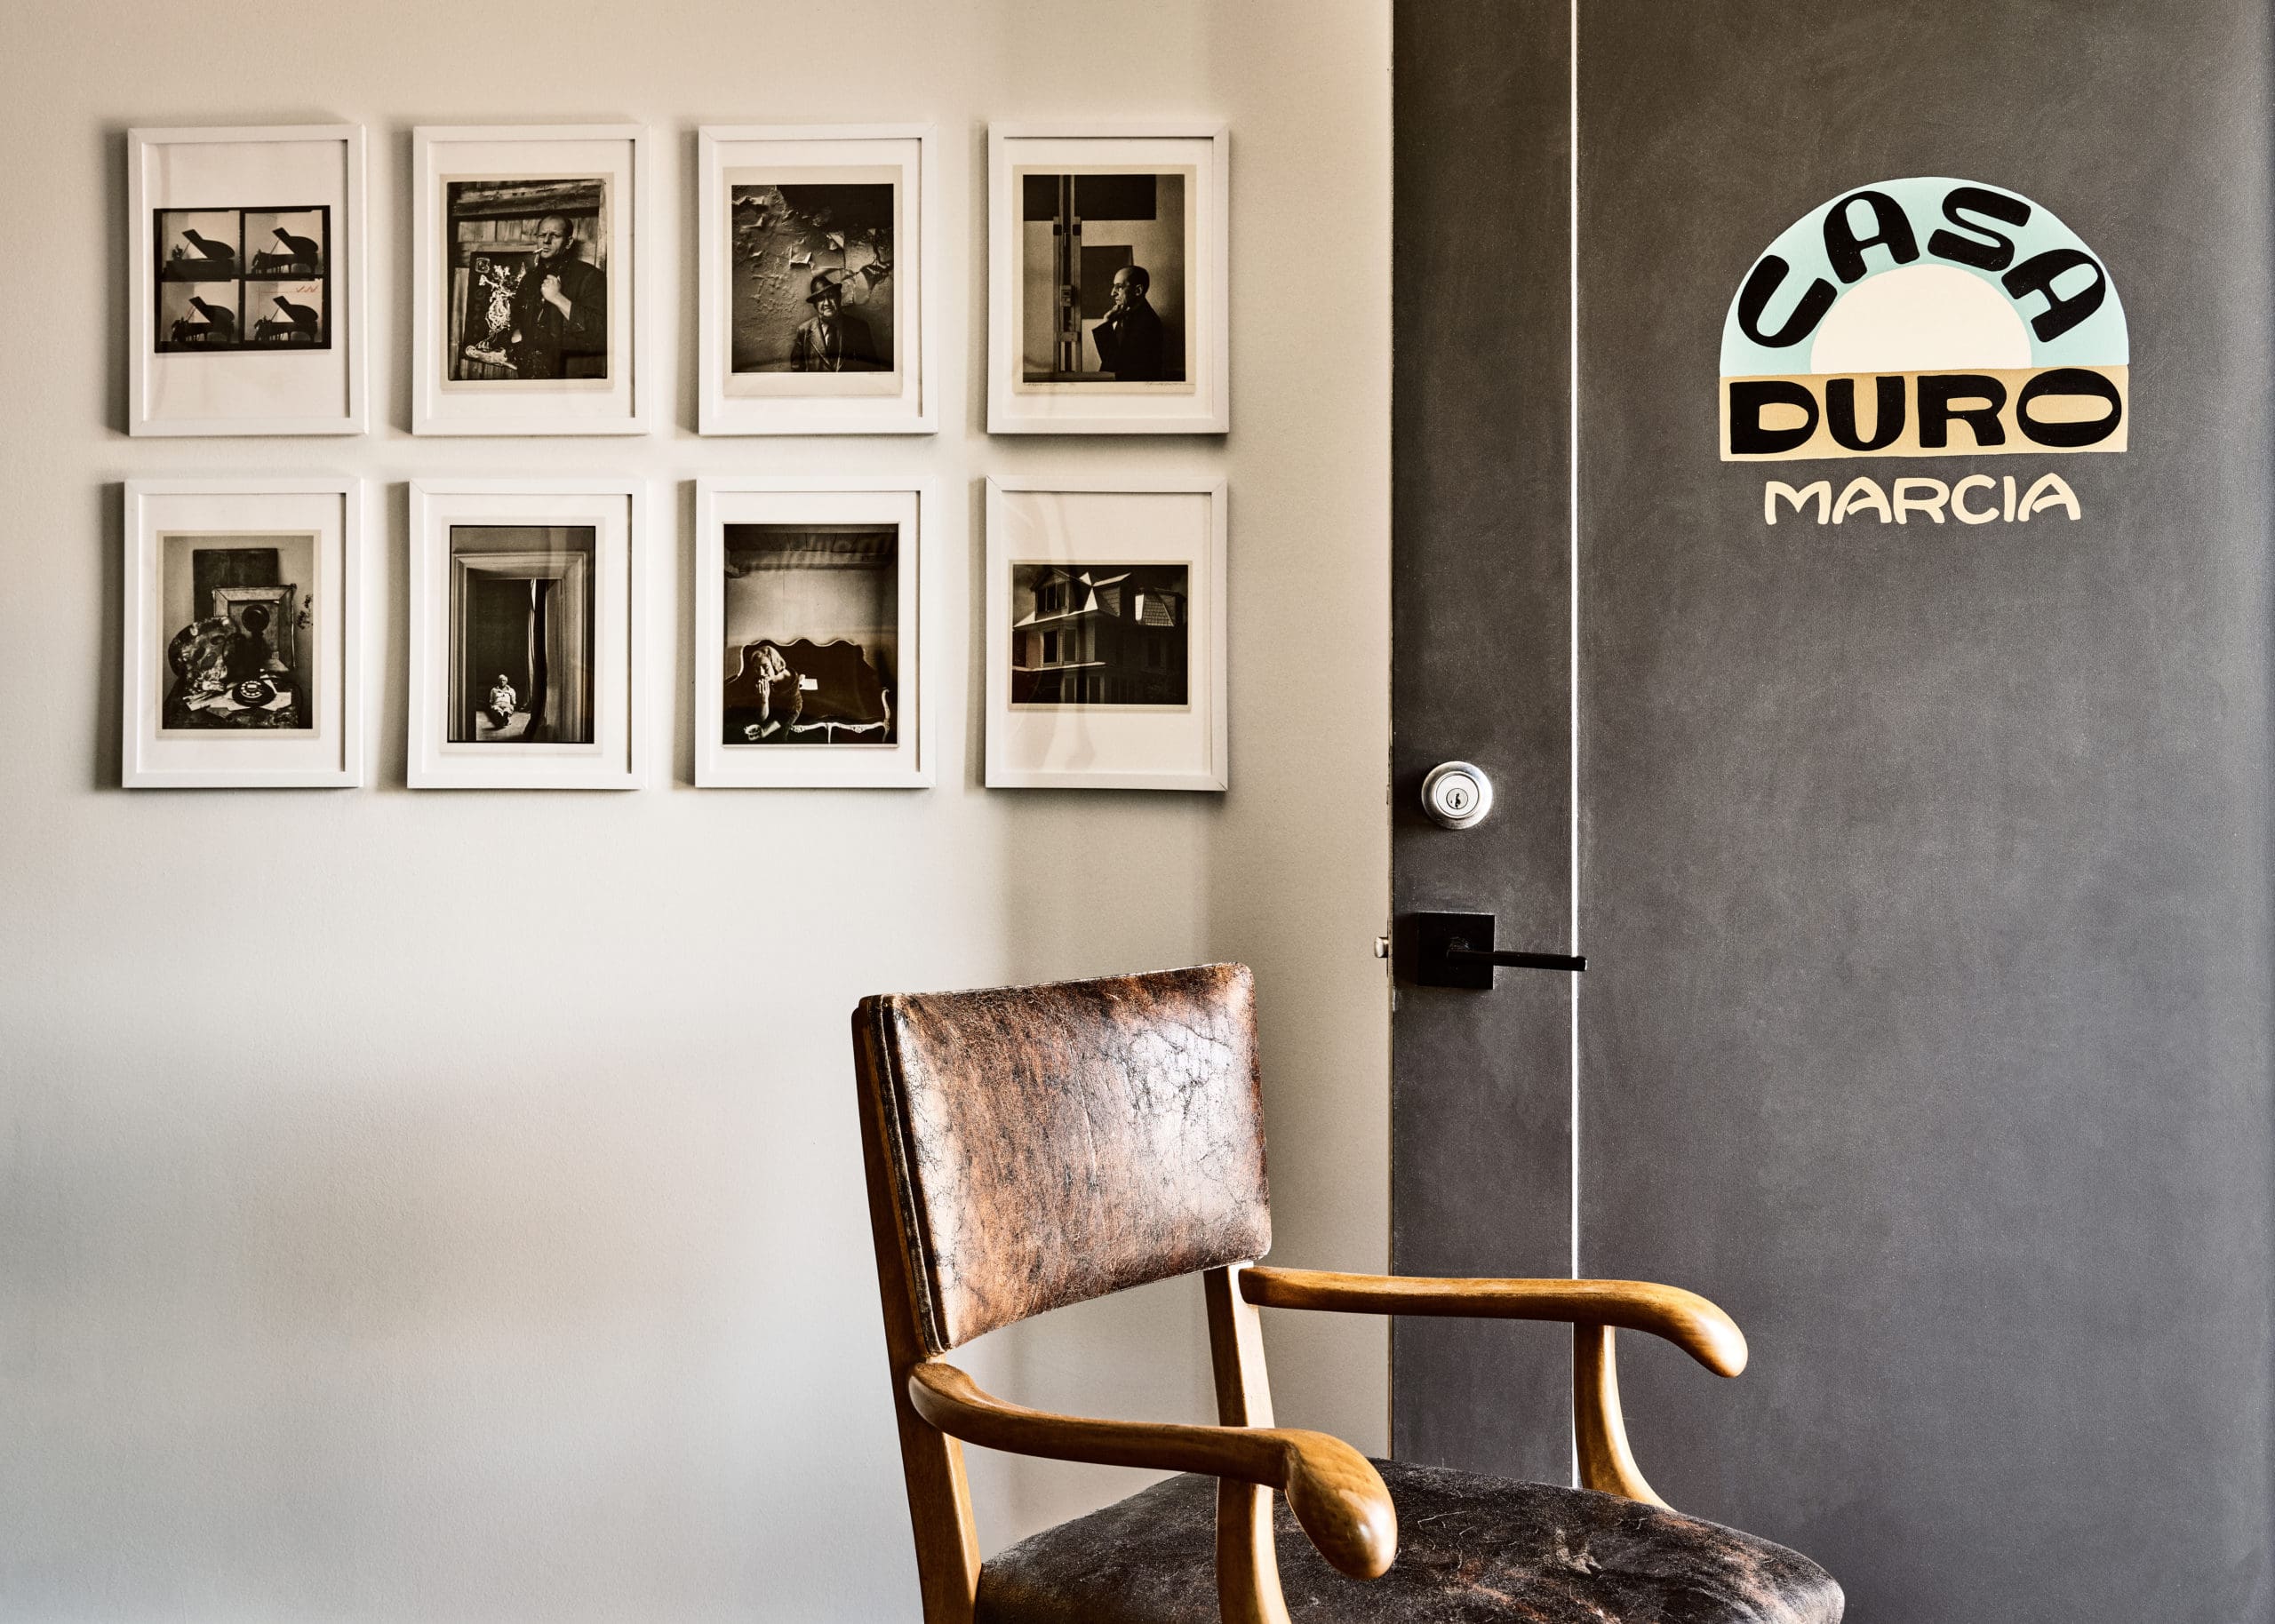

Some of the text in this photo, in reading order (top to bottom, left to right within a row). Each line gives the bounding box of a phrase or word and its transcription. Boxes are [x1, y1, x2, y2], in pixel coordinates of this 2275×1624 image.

[1737, 187, 2106, 348] CASA
[1729, 368, 2122, 455] DURO
[1764, 473, 2081, 525] MARCIA
